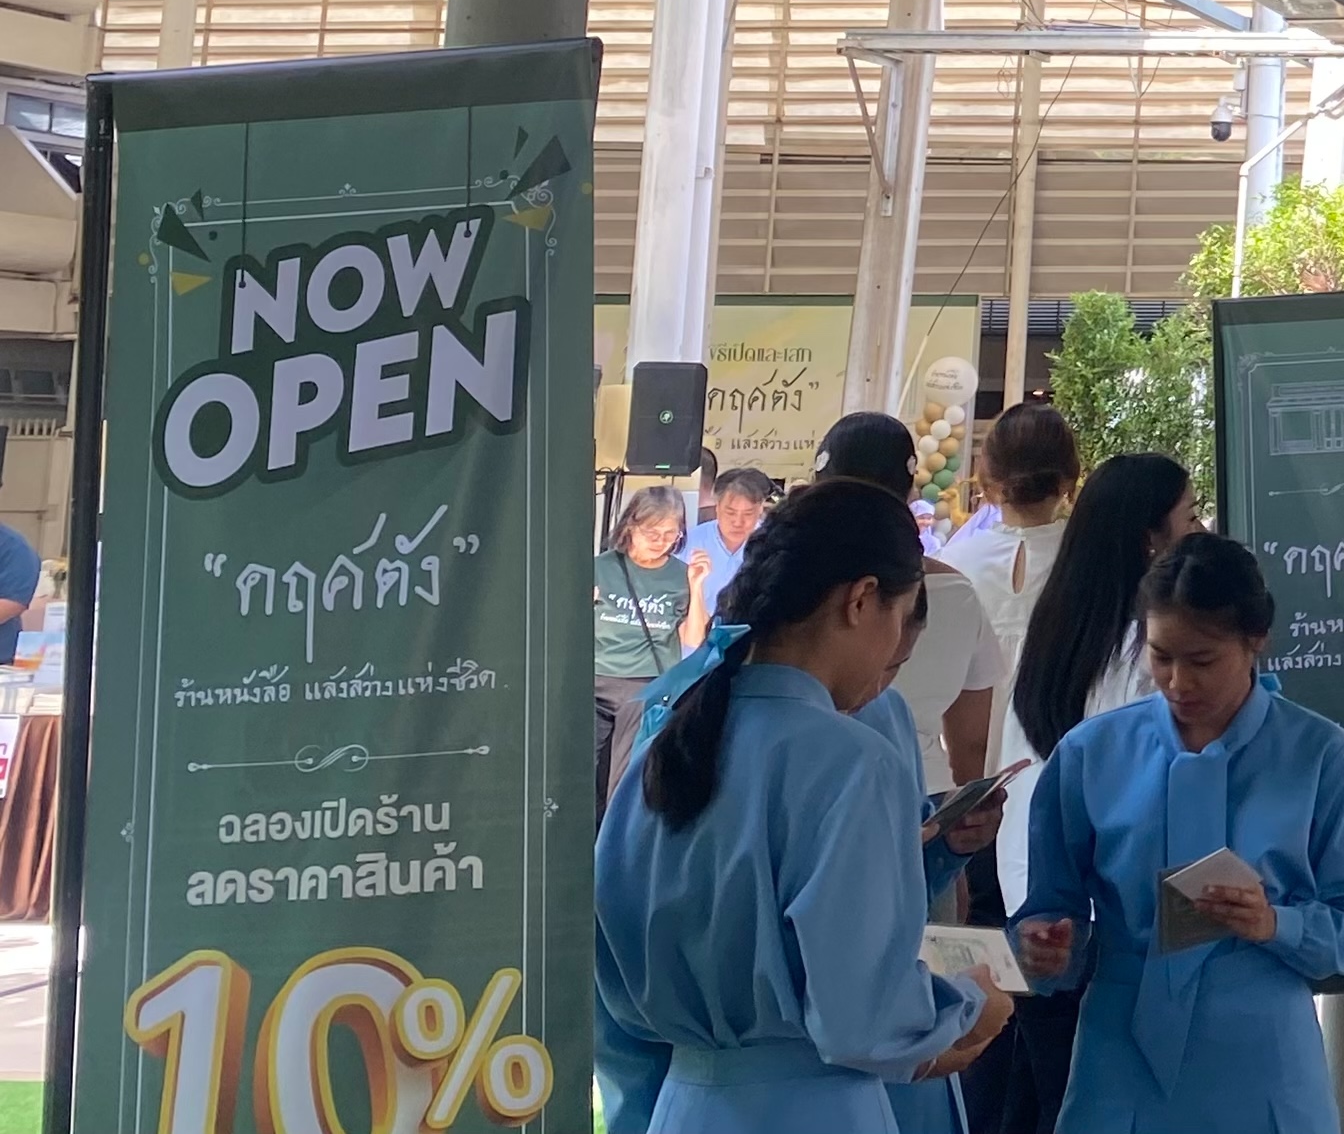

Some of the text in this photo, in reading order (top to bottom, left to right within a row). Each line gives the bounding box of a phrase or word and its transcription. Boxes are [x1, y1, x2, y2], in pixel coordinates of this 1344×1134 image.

[231, 218, 481, 355] NOW
[163, 310, 517, 488] OPEN
[174, 664, 291, 707] ร้านหนังสือ
[218, 795, 450, 843] ฉลองเปิดร้าน
[186, 841, 483, 906] ลดราคาสินค้า
[124, 946, 553, 1134] 10%
